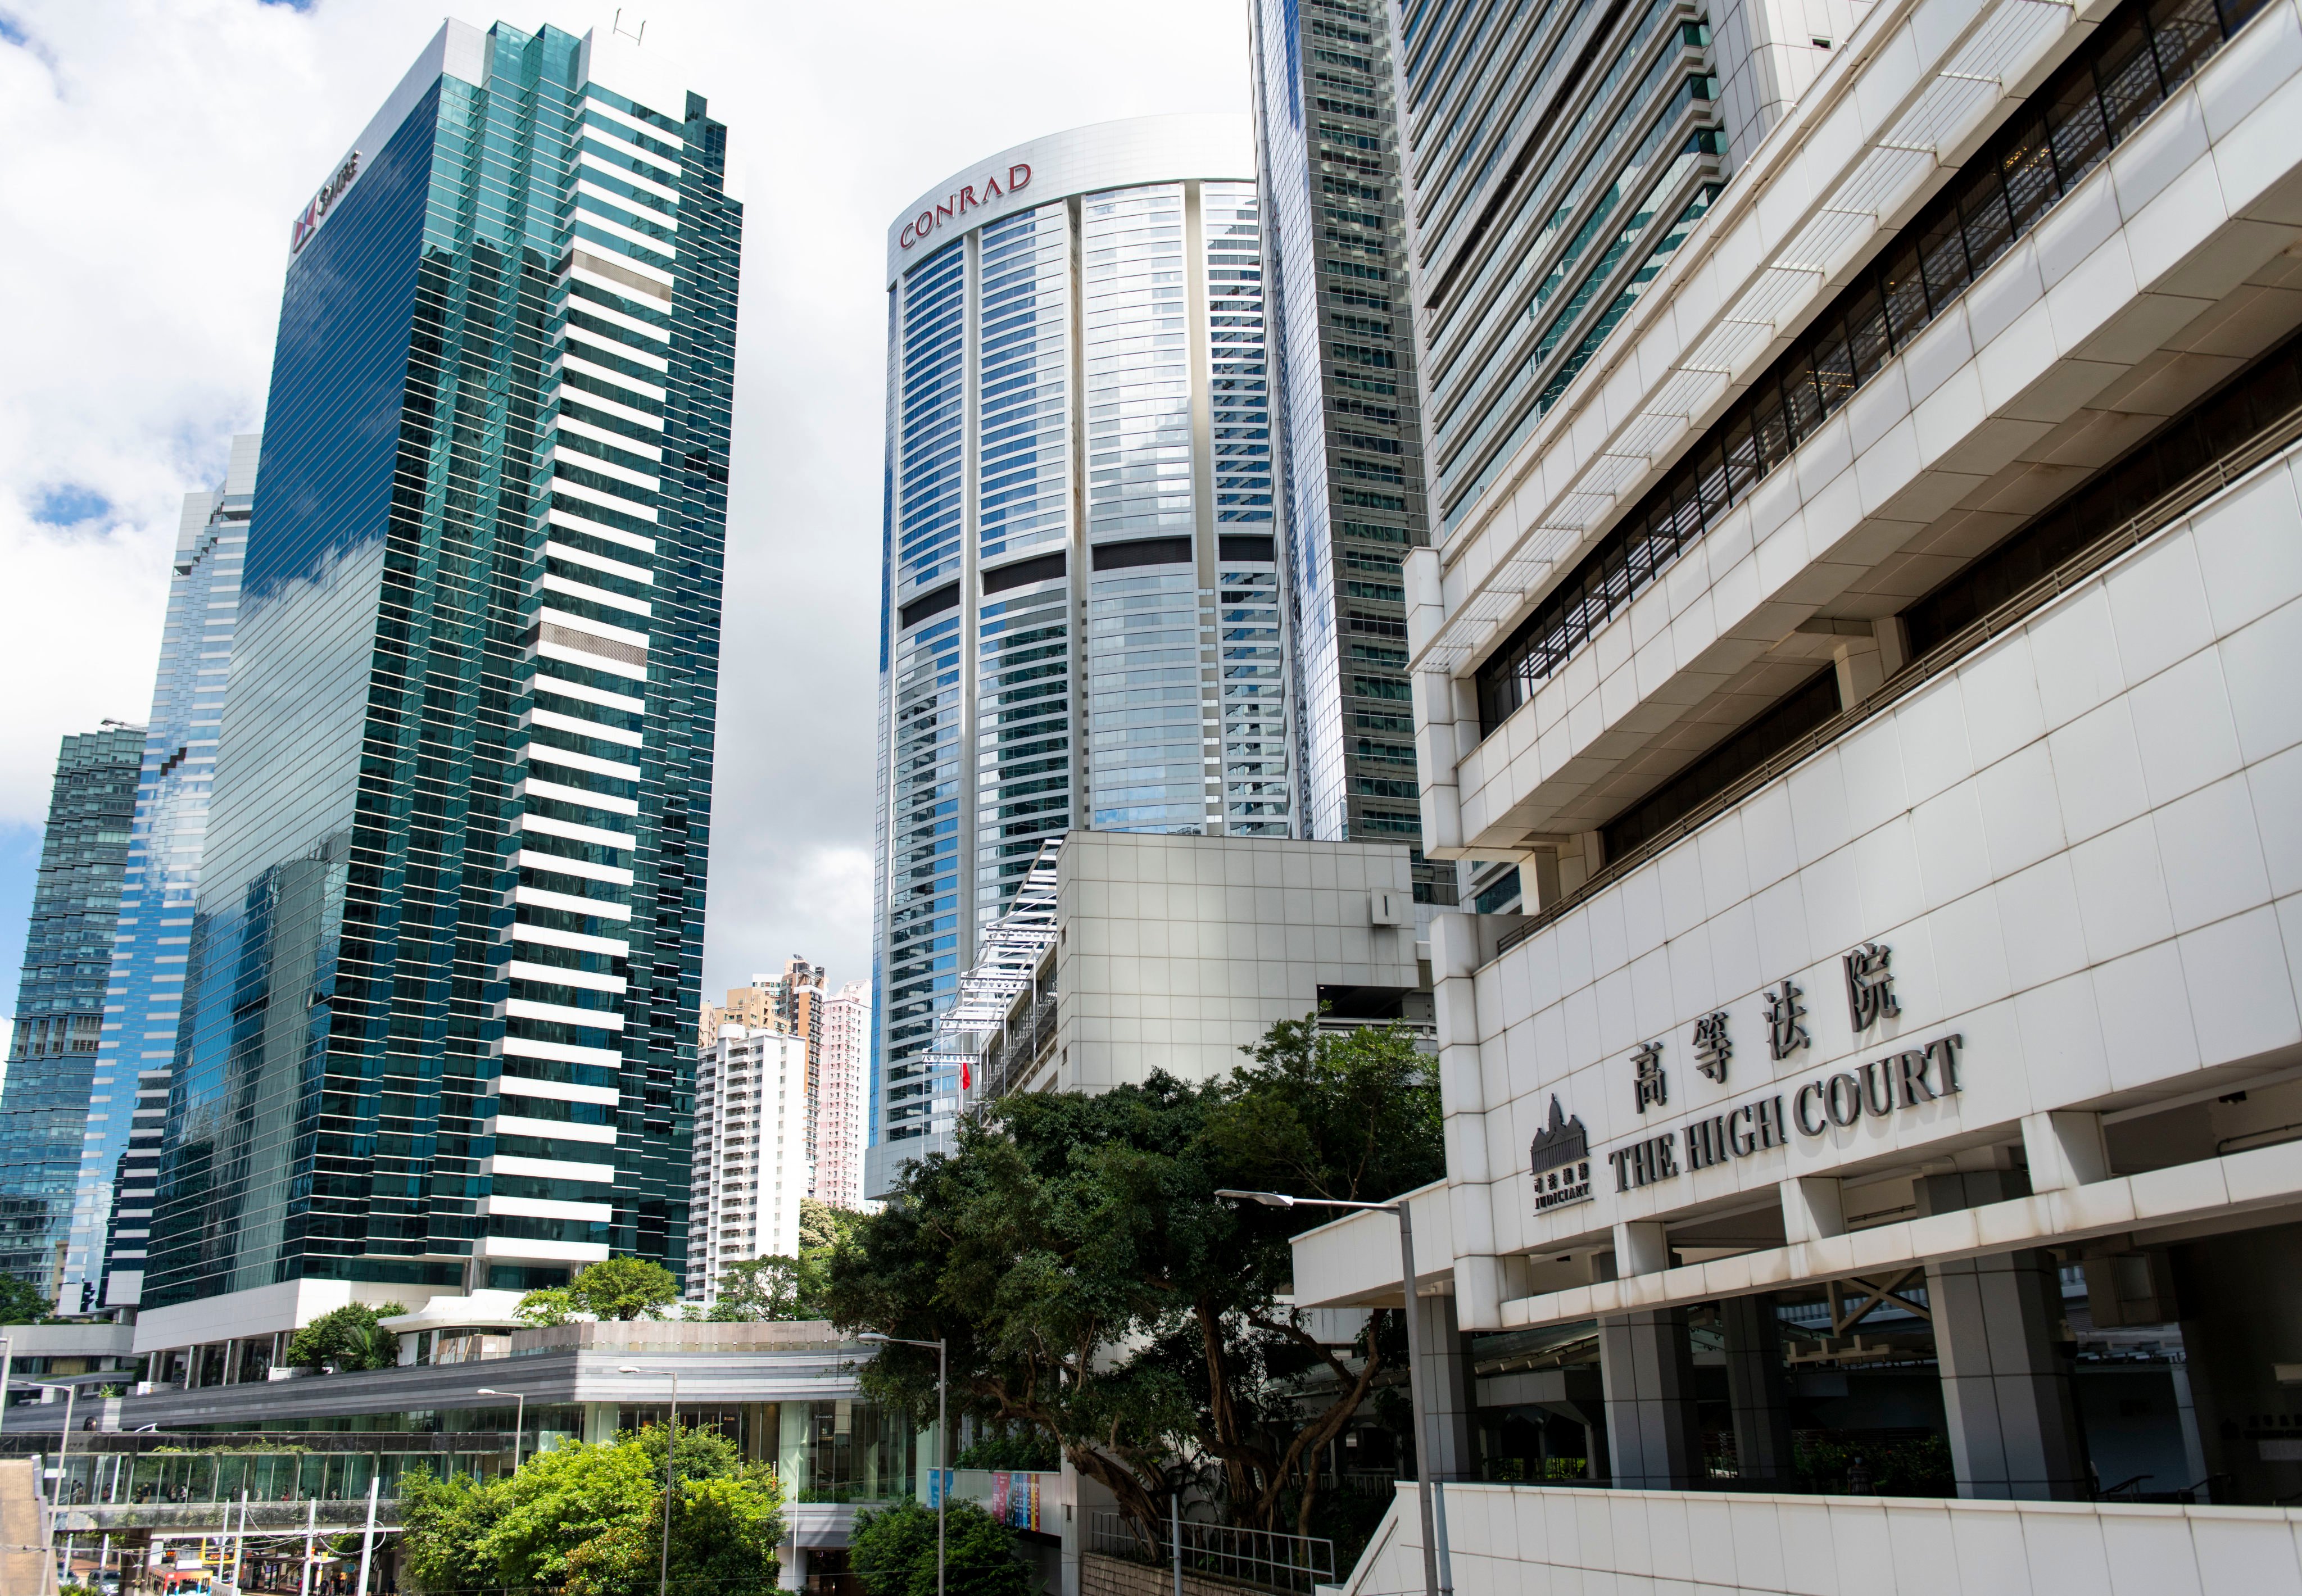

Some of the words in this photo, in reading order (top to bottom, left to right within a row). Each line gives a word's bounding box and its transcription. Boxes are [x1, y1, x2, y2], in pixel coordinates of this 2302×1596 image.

[900, 164, 1033, 249] CONRAD
[1630, 942, 1902, 1114] 高等法院
[1608, 1133, 1679, 1193] THE
[1680, 1095, 1788, 1173] HIGH
[1793, 1033, 1964, 1137] COURT
[1535, 1183, 1589, 1209] JUDICIARY
